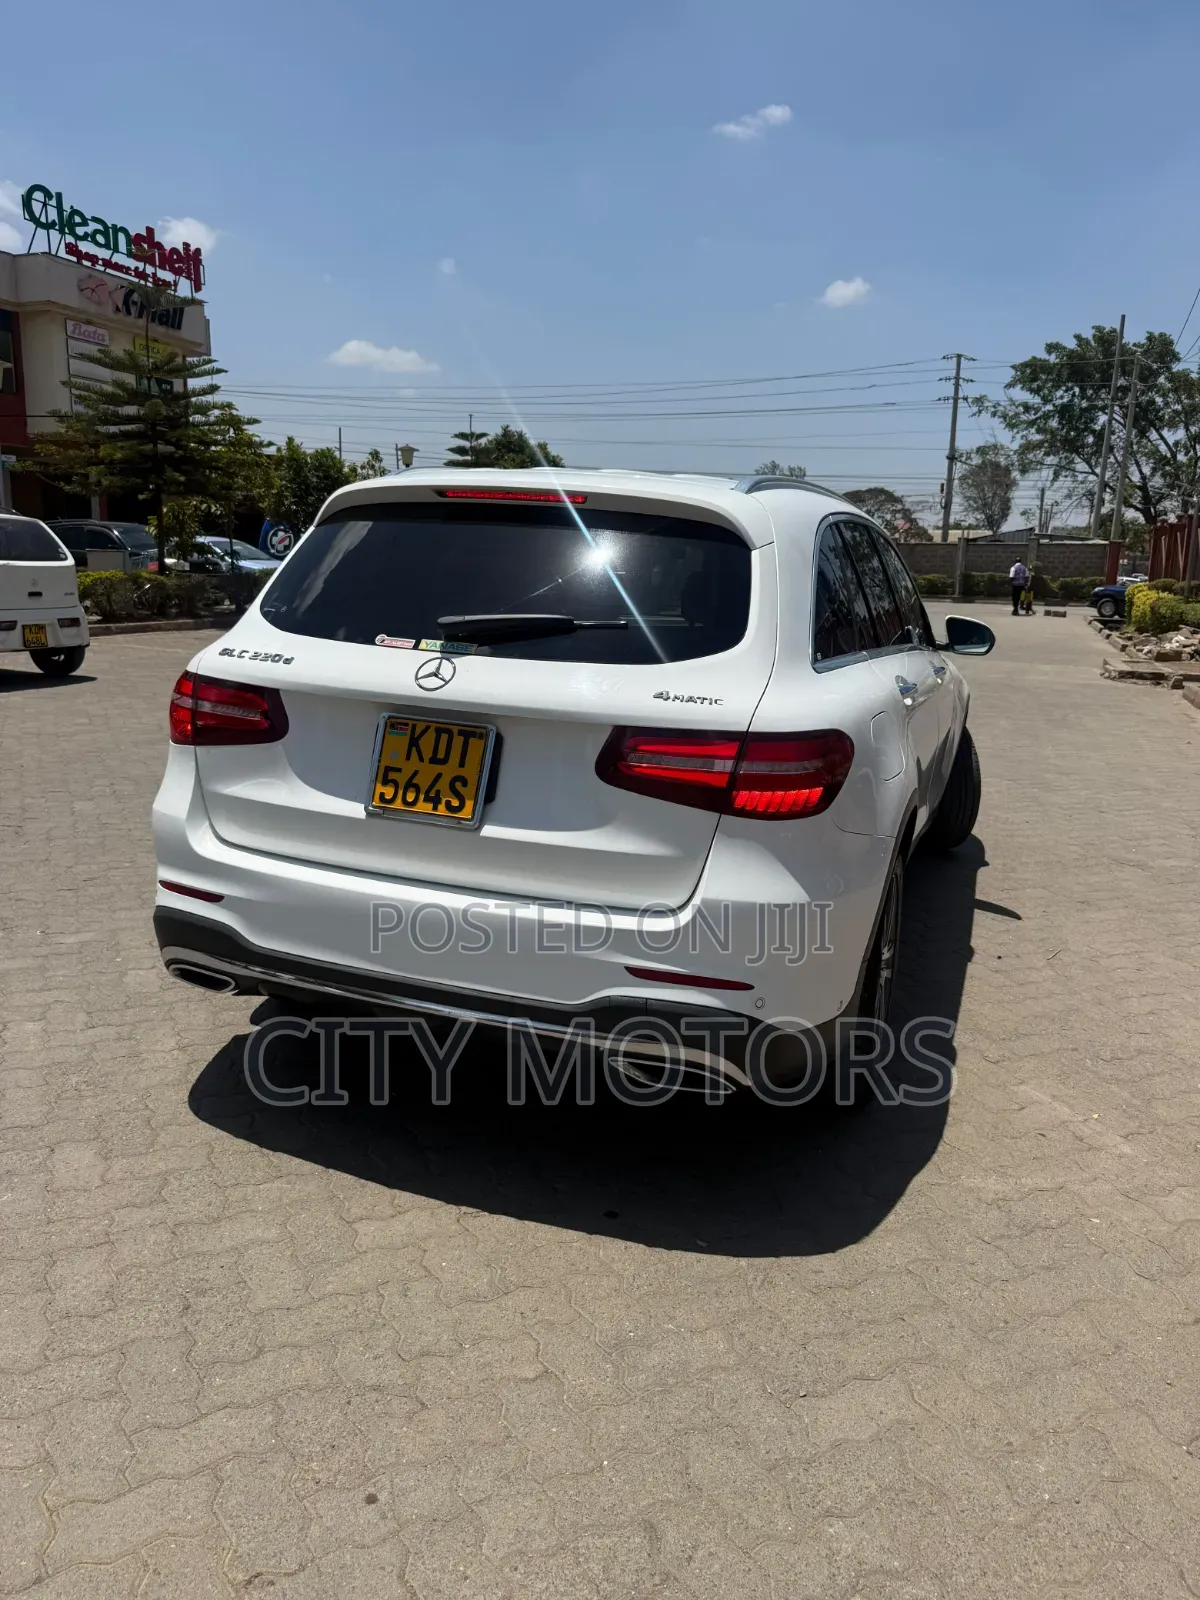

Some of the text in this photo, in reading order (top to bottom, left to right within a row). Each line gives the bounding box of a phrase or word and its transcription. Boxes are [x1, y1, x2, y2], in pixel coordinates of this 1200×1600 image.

[24, 183, 203, 293] Cleanshelf
[70, 321, 107, 343] Bata
[218, 647, 250, 659] GLC
[424, 640, 476, 653] YANASE
[652, 690, 724, 706] 4MATIC
[405, 723, 478, 768] KDT
[378, 765, 469, 815] 564S
